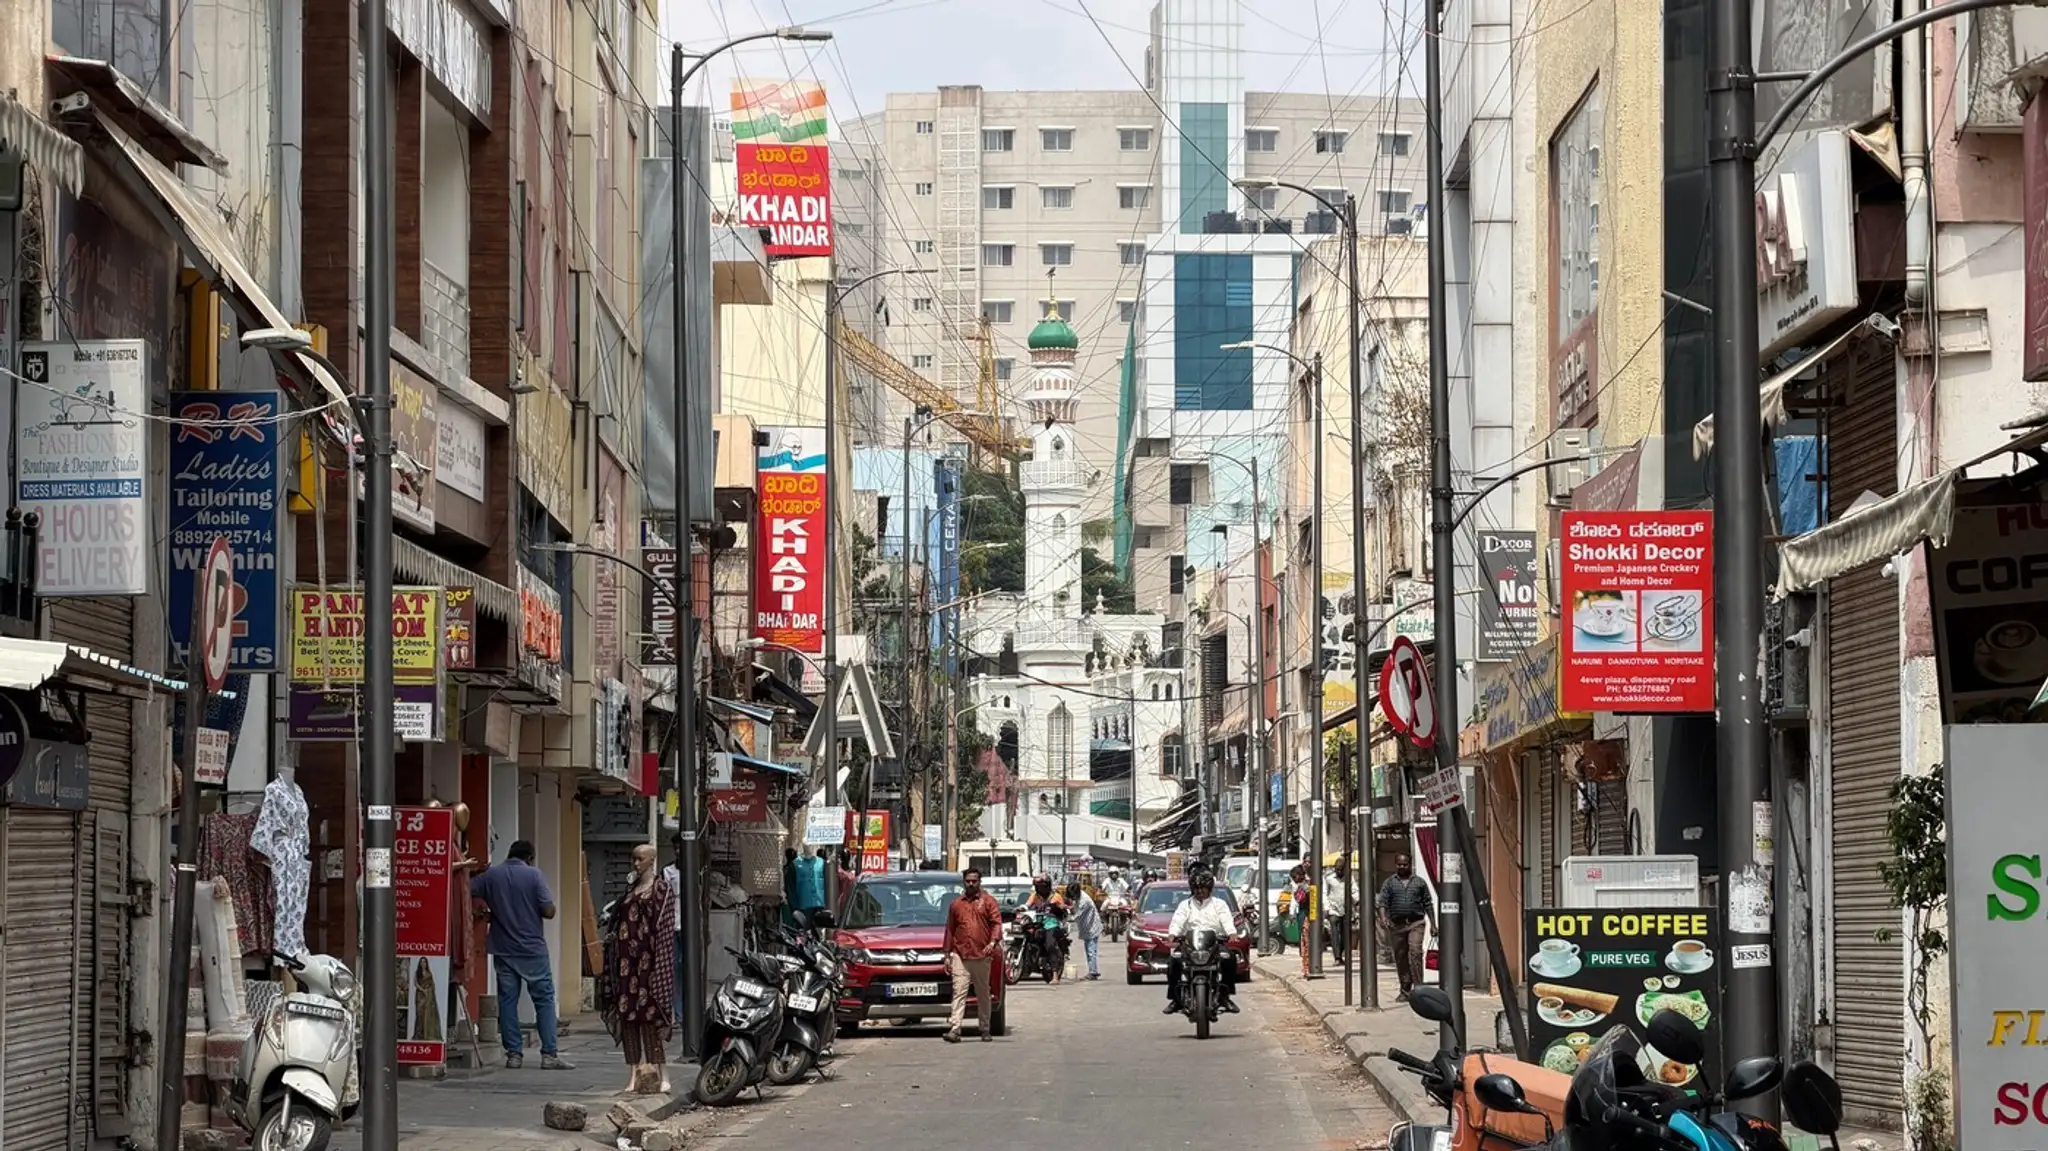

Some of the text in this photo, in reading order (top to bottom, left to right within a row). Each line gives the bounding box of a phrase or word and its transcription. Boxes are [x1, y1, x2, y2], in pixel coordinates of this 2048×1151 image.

[740, 195, 828, 223] KHADI
[765, 225, 830, 246] ANDAR
[24, 457, 60, 478] Boutique
[72, 457, 109, 478] Designer
[112, 454, 139, 473] Studio
[175, 451, 272, 480] Ladies
[24, 481, 139, 497] DRESS MATERIALS AVAILABLE
[174, 488, 273, 510] Tailoring
[53, 504, 135, 542] HOURS
[198, 511, 249, 525] Mobile
[173, 547, 274, 570] Wihin
[1569, 543, 1705, 560] Shokki Decor
[770, 517, 811, 611] KHADI
[1574, 564, 1700, 575] Premium Japanese Crockery
[1601, 577, 1674, 586] and Home Decor
[172, 642, 273, 664] Hurs
[403, 639, 432, 648] Sheets,
[1630, 675, 1674, 685] dispensary
[1677, 675, 1696, 683] road
[1537, 914, 1708, 936] HOT COFFEE
[1591, 953, 1650, 965] PURE VEG
[1735, 950, 1768, 961] JESUS
[1987, 1010, 2048, 1047] FI
